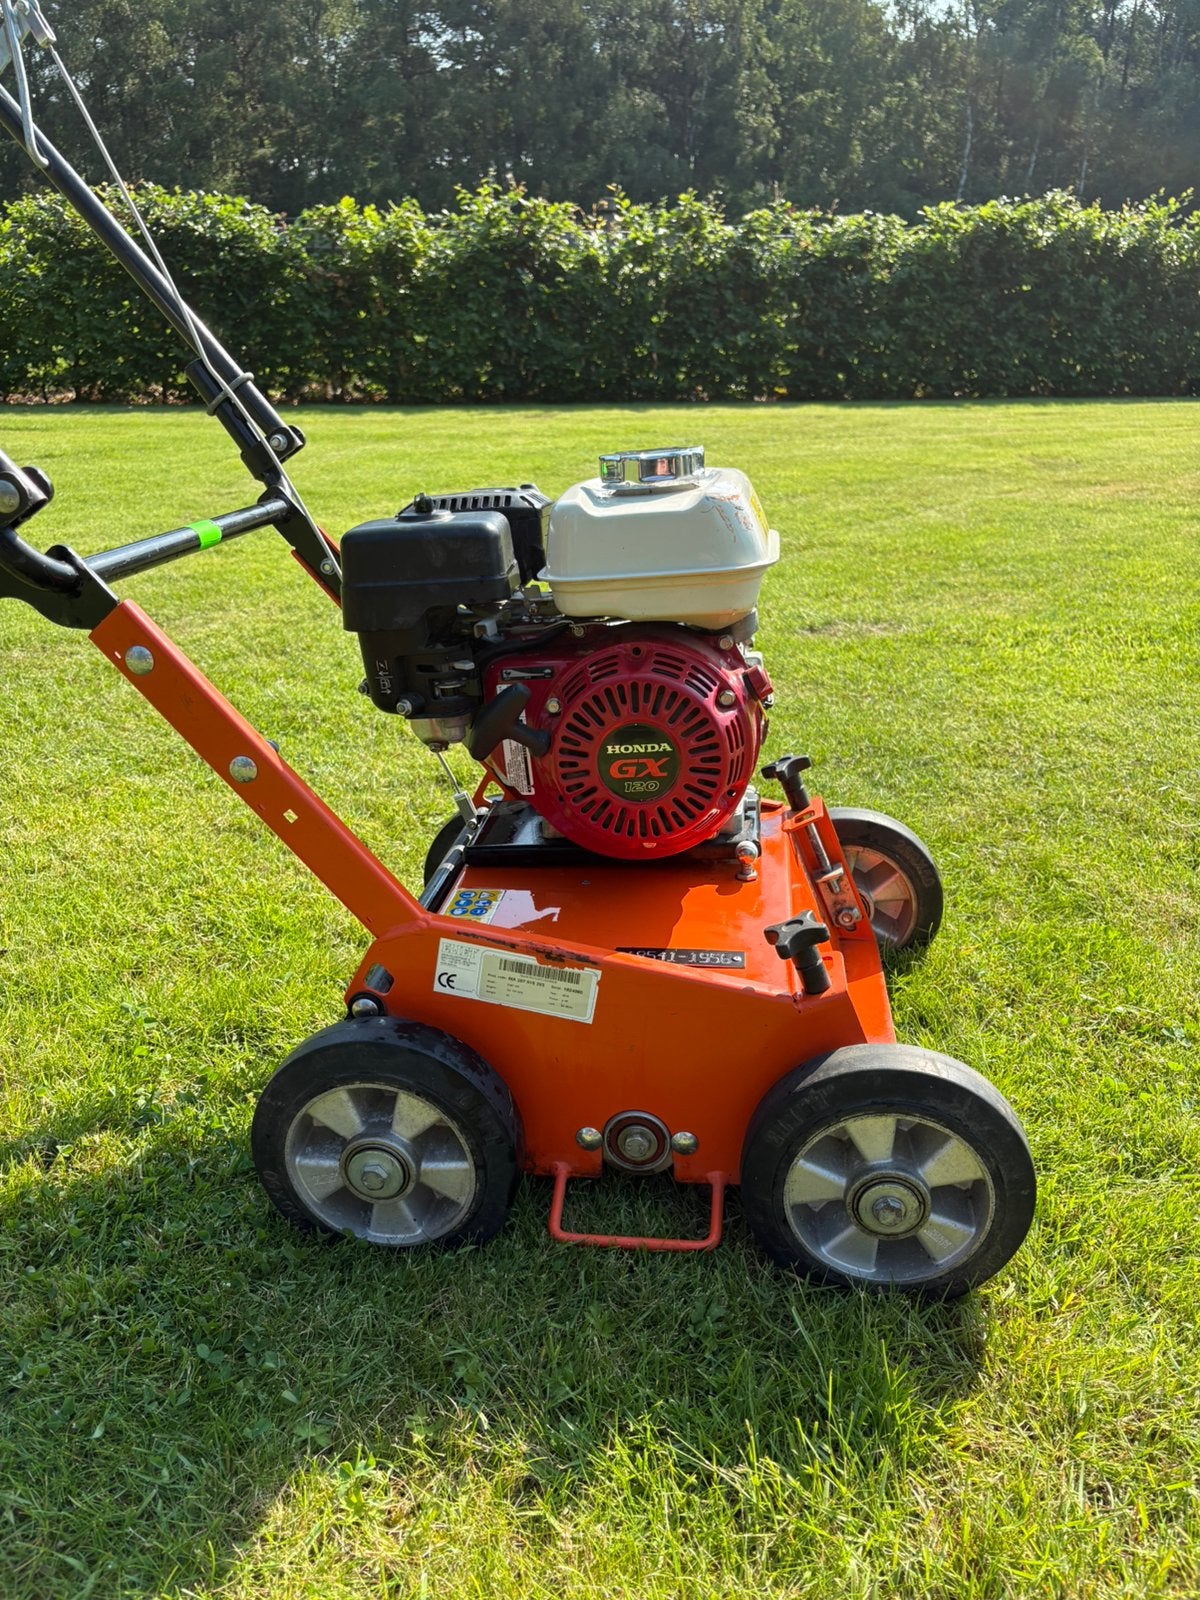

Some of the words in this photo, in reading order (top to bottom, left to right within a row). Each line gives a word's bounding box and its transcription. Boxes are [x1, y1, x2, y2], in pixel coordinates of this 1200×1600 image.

[606, 743, 673, 754] HONDA
[610, 757, 670, 778] GX
[625, 781, 659, 792] 120
[438, 972, 457, 989] CE
